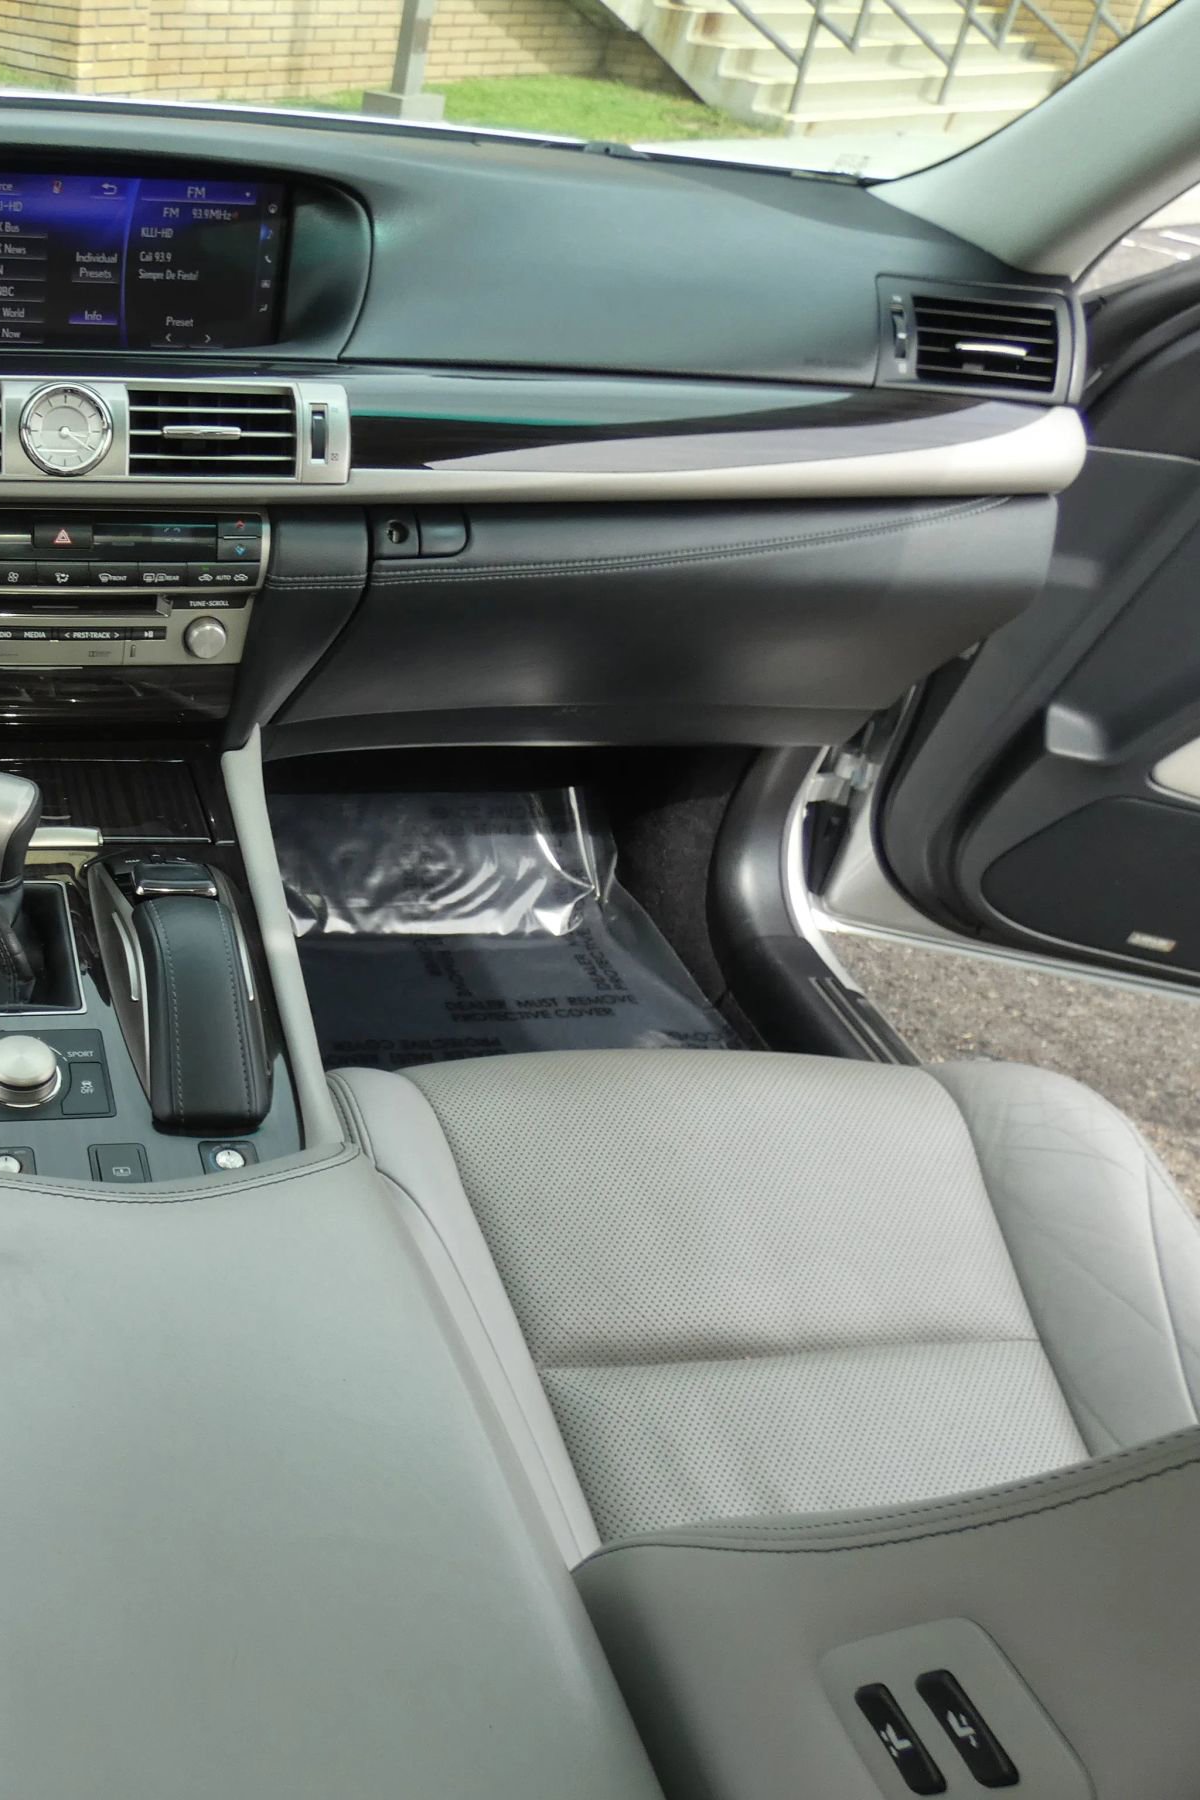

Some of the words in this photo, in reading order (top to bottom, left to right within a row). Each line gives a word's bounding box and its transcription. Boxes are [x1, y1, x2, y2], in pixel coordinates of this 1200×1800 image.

[187, 186, 206, 199] FM
[163, 207, 180, 218] FM
[4, 244, 26, 255] News
[75, 251, 118, 264] Individual
[79, 266, 113, 279] Presets
[2, 308, 25, 318] World
[84, 310, 103, 321] Info
[166, 316, 194, 328] Preset
[1, 329, 21, 339] Now
[516, 998, 557, 1008] MUST
[567, 995, 638, 1006] REMOVE
[67, 1050, 95, 1058] SPORT
[80, 1087, 95, 1095] OFF
